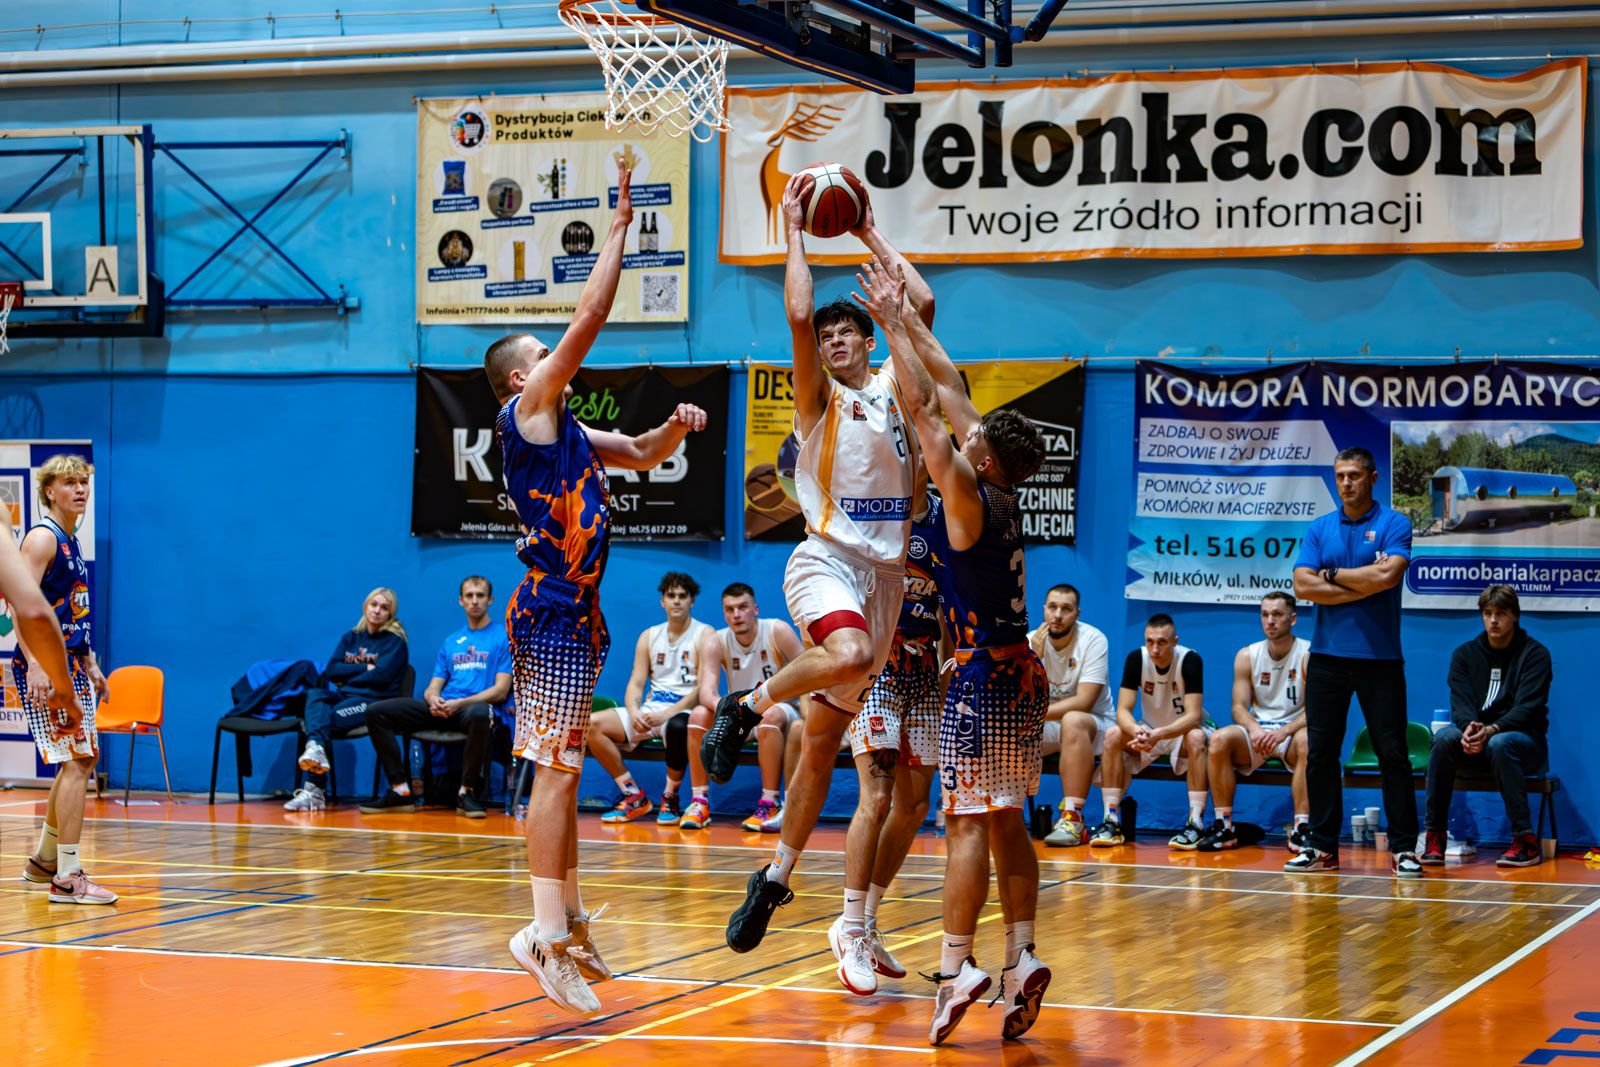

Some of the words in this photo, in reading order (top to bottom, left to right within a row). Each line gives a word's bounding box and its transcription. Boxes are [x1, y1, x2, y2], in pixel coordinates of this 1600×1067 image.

[495, 111, 574, 126] Dystrybucja
[495, 127, 573, 142] Produktów
[864, 91, 1542, 192] Jelonka.com
[939, 204, 1059, 242] Twoje
[1073, 196, 1201, 236] źródło
[1216, 191, 1424, 233] informacji
[88, 258, 116, 292] A
[426, 306, 459, 315] Infolinia
[514, 305, 576, 316] info@proart.biz
[1144, 374, 1309, 408] KOMORA
[1147, 424, 1206, 440] ZADBAJ
[1209, 427, 1222, 441] O
[1226, 427, 1280, 441] SWOJE
[1147, 444, 1217, 460] ZDROWIE
[1220, 447, 1225, 460] I
[1228, 443, 1255, 461] ŻYJ
[1259, 443, 1312, 461] DŁUŻEJ
[1144, 478, 1212, 495] POMNÓŻ
[1214, 482, 1267, 496] SWOJE
[1143, 497, 1215, 514] KOMÓRKI
[1217, 502, 1316, 516] MACIERZYSTE
[459, 522, 487, 532] Jelenia
[488, 522, 506, 532] Góra
[507, 524, 516, 532] ul.
[651, 525, 665, 534] 617
[666, 525, 676, 534] 22
[677, 525, 688, 534] 09
[1154, 534, 1198, 557] tel.
[1207, 536, 1255, 559] 516
[1264, 537, 1303, 560] 07
[1153, 570, 1222, 589] MIŁKÓW,
[1227, 574, 1245, 588] ul.
[1521, 583, 1552, 592] TLENEM
[763, 666, 773, 681] 6
[1287, 685, 1297, 706] 4
[1172, 697, 1185, 715] 5
